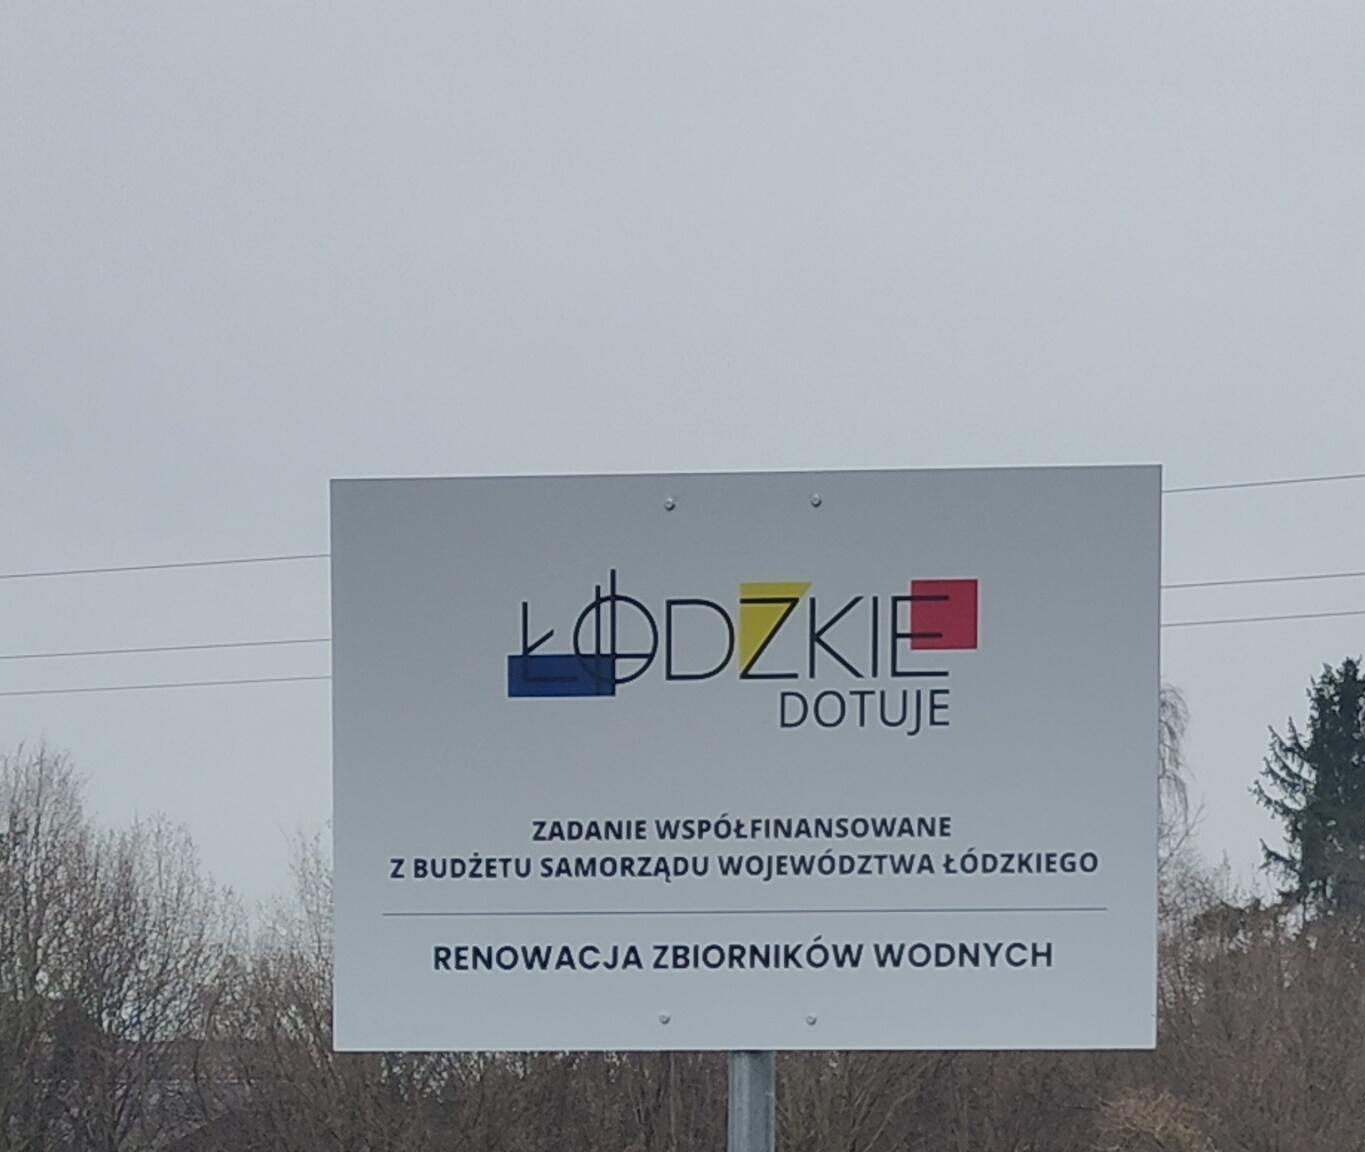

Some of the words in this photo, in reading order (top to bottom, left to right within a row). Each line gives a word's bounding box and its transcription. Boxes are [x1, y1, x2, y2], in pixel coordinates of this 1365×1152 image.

[779, 688, 950, 736] DOTUJE
[532, 820, 648, 842] ZADANIE
[655, 813, 952, 841] WSPÓŁFINANSOWANE
[389, 858, 405, 879] Z
[413, 852, 532, 879] BUDŻETU
[539, 856, 710, 883] SAMORZĄDU
[718, 849, 936, 882] WOJEWÓDZTWA
[942, 847, 1099, 875] ŁÓDZKIEGO
[433, 945, 644, 971] RENOWACJA
[652, 935, 864, 970] ZBIORNIKÓW
[873, 942, 1053, 969] WODNYCH
